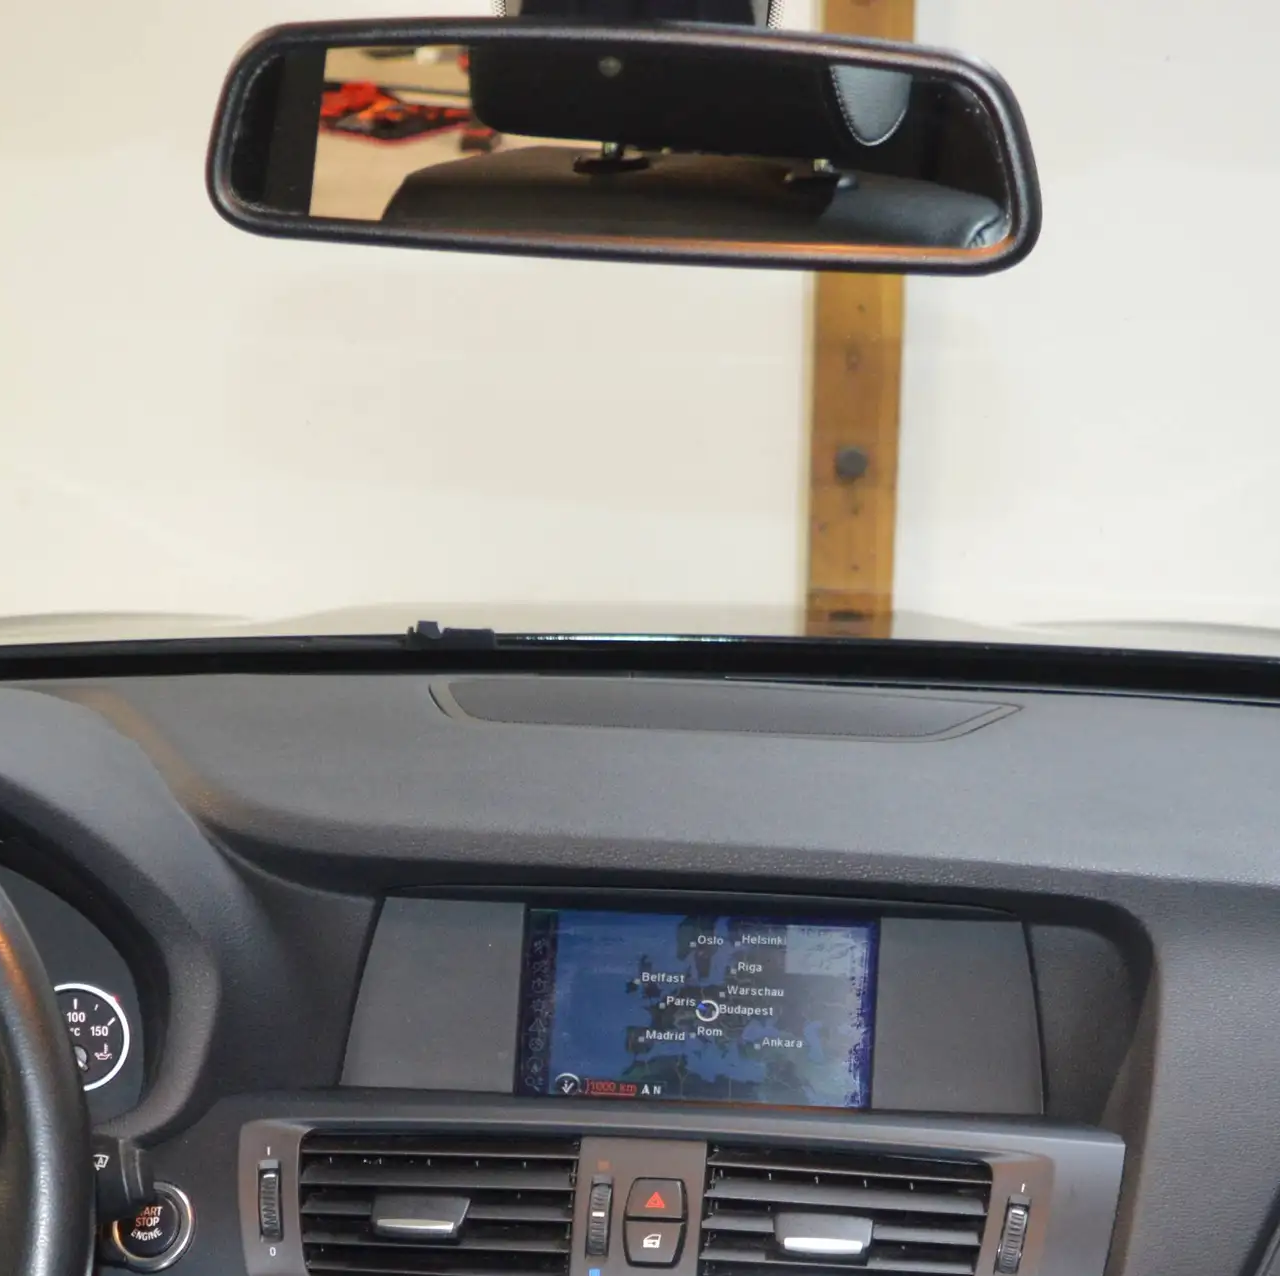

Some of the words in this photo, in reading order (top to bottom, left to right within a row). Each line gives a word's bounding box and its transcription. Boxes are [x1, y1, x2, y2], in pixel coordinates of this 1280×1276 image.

[697, 935, 724, 945] Oslo
[742, 935, 787, 945] Helsinki
[738, 962, 762, 974] Riga
[642, 973, 685, 983] Belfast
[727, 986, 784, 997] Warschau
[666, 996, 696, 1007] Paris
[719, 1005, 773, 1017] Budapest
[66, 1011, 86, 1023] 100
[90, 1026, 108, 1037] 150
[646, 1030, 685, 1041] Madrid
[697, 1027, 723, 1036] Rom
[762, 1037, 803, 1048] Ankara
[135, 1216, 160, 1227] STOP
[131, 1228, 163, 1241] ENGINE
